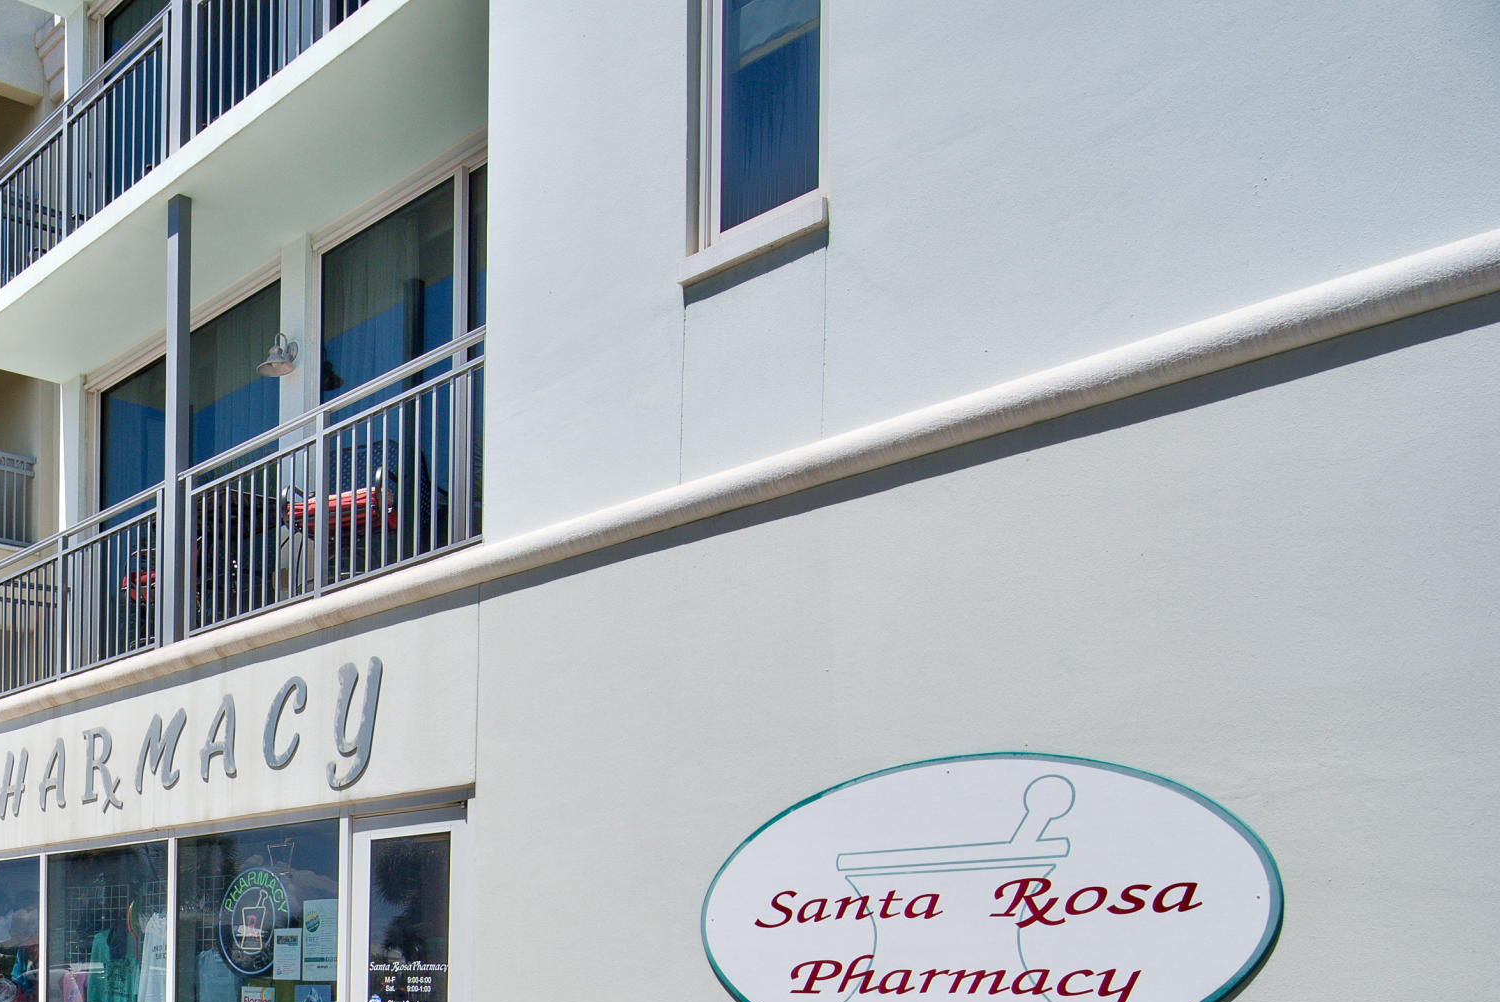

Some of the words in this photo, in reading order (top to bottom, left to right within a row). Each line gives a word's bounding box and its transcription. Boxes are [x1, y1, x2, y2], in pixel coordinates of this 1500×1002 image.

[223, 871, 289, 913] PHARMACY
[754, 889, 944, 930] Santa
[989, 877, 1204, 929] Rosa
[369, 961, 391, 972] Santa
[411, 960, 449, 973] Pharmacy
[384, 976, 397, 984] M-F
